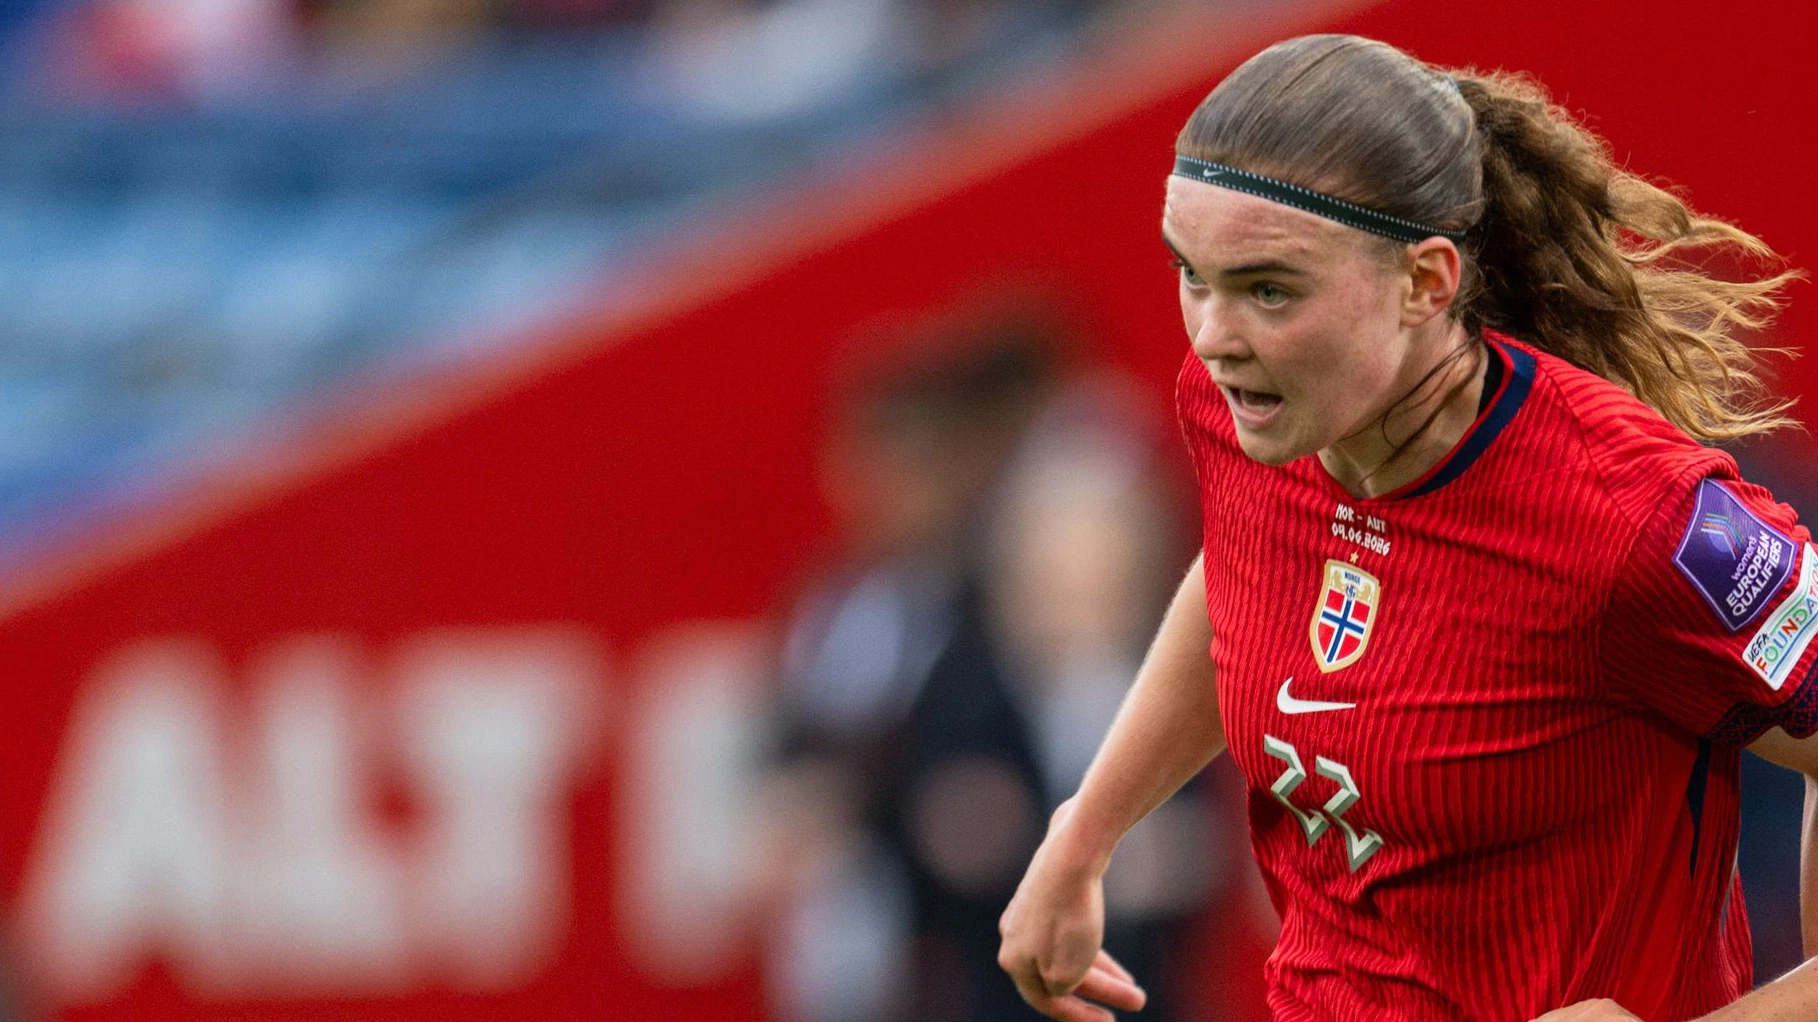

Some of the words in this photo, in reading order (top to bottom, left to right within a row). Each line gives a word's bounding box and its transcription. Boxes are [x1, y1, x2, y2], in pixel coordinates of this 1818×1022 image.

[1331, 522, 1391, 556] 09.06.2026
[1335, 503, 1354, 522] NOR
[1366, 514, 1386, 533] AUT
[1725, 530, 1770, 608] EUROPEAN
[1732, 538, 1782, 616] QUALIFIERS
[1748, 632, 1770, 662] UEFA
[1264, 734, 1384, 874] 22
